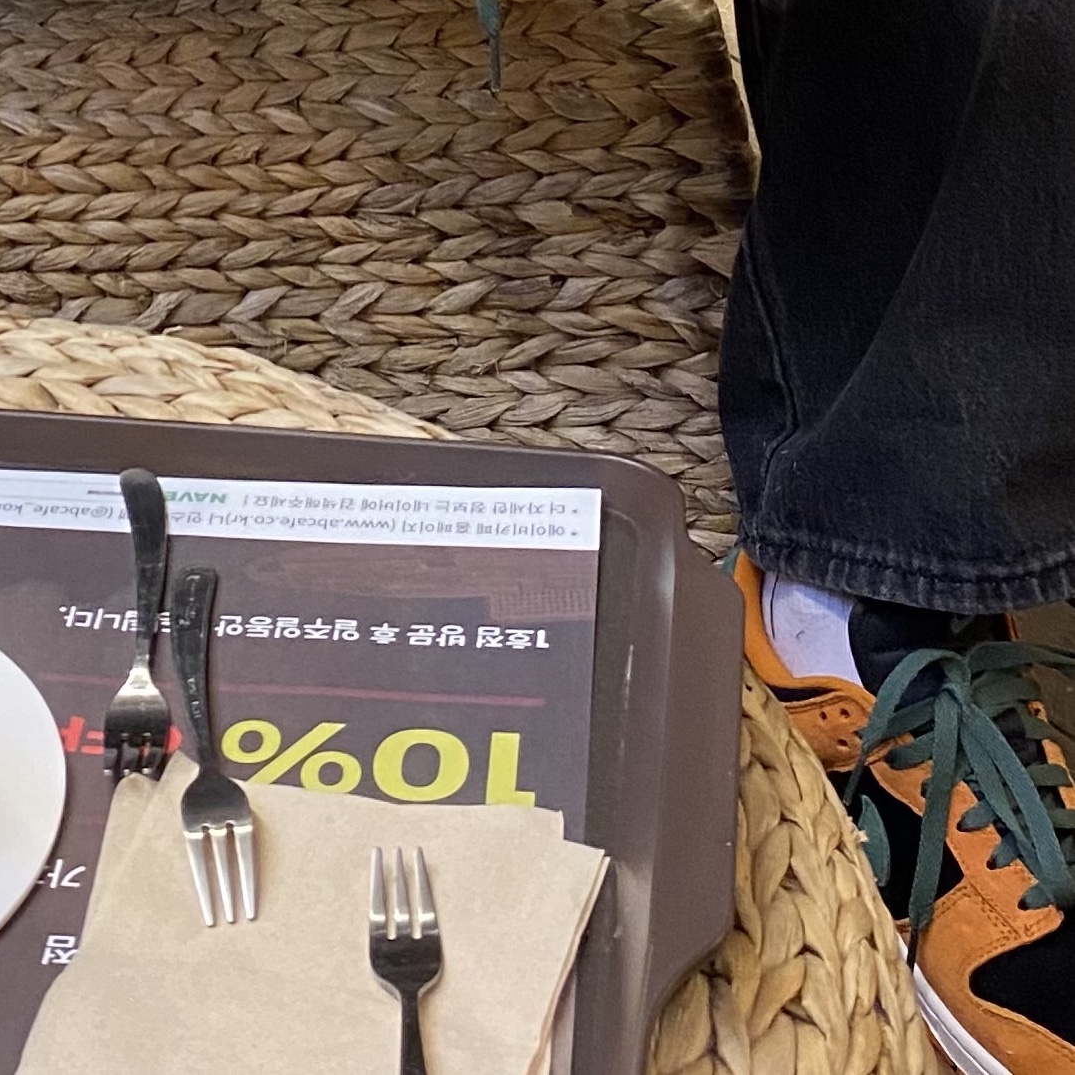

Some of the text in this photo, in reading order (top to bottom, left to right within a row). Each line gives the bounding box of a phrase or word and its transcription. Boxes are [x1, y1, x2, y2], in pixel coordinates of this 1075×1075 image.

[163, 490, 226, 505] NAVE
[361, 498, 429, 513] 네이버에
[435, 500, 486, 514] 정보는
[492, 501, 543, 515] 자세한
[549, 502, 565, 515] 더
[401, 520, 470, 535] 홈페이지
[476, 522, 566, 537] 에이비카페
[214, 615, 360, 641] 일주일동안
[369, 622, 400, 645] 후
[405, 623, 466, 648] 방문
[475, 625, 549, 650] 1호점
[221, 718, 536, 805] 10%
